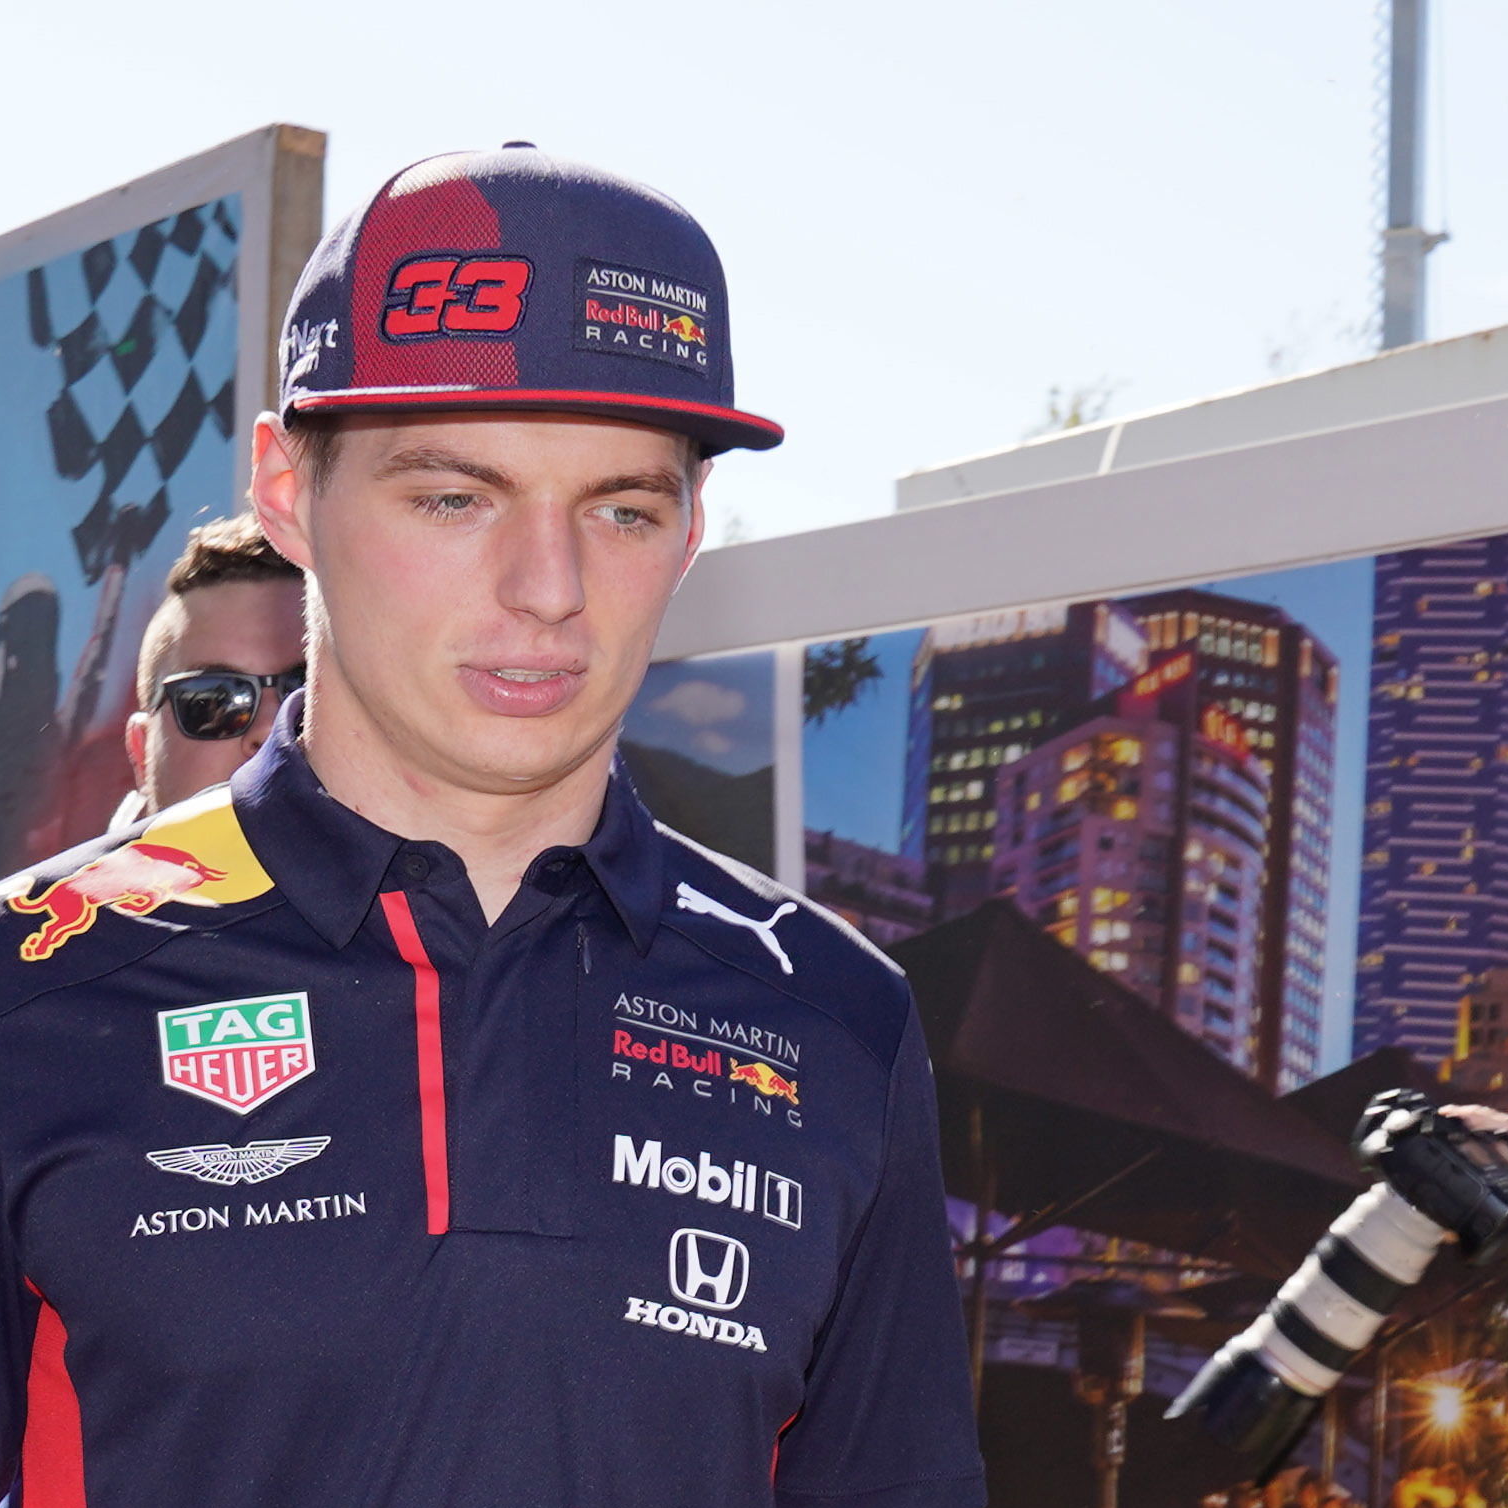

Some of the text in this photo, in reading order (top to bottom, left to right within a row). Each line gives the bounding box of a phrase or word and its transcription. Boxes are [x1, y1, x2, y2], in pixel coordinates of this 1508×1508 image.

[383, 254, 532, 340] 33
[587, 267, 707, 313] ASTON MARTIN
[585, 298, 660, 331] Red Bull
[585, 325, 708, 366] RACING
[171, 1002, 298, 1045] TAG
[613, 991, 801, 1064] ASTON MARTIN
[173, 1047, 305, 1103] HEUER
[612, 1029, 722, 1077] Red Bull
[610, 1061, 803, 1129] RACING
[202, 1148, 278, 1163] ASTON MARTIN
[612, 1133, 758, 1214] Mobil
[129, 1191, 369, 1239] ASTON MARTIN
[623, 1296, 769, 1354] HONDA
